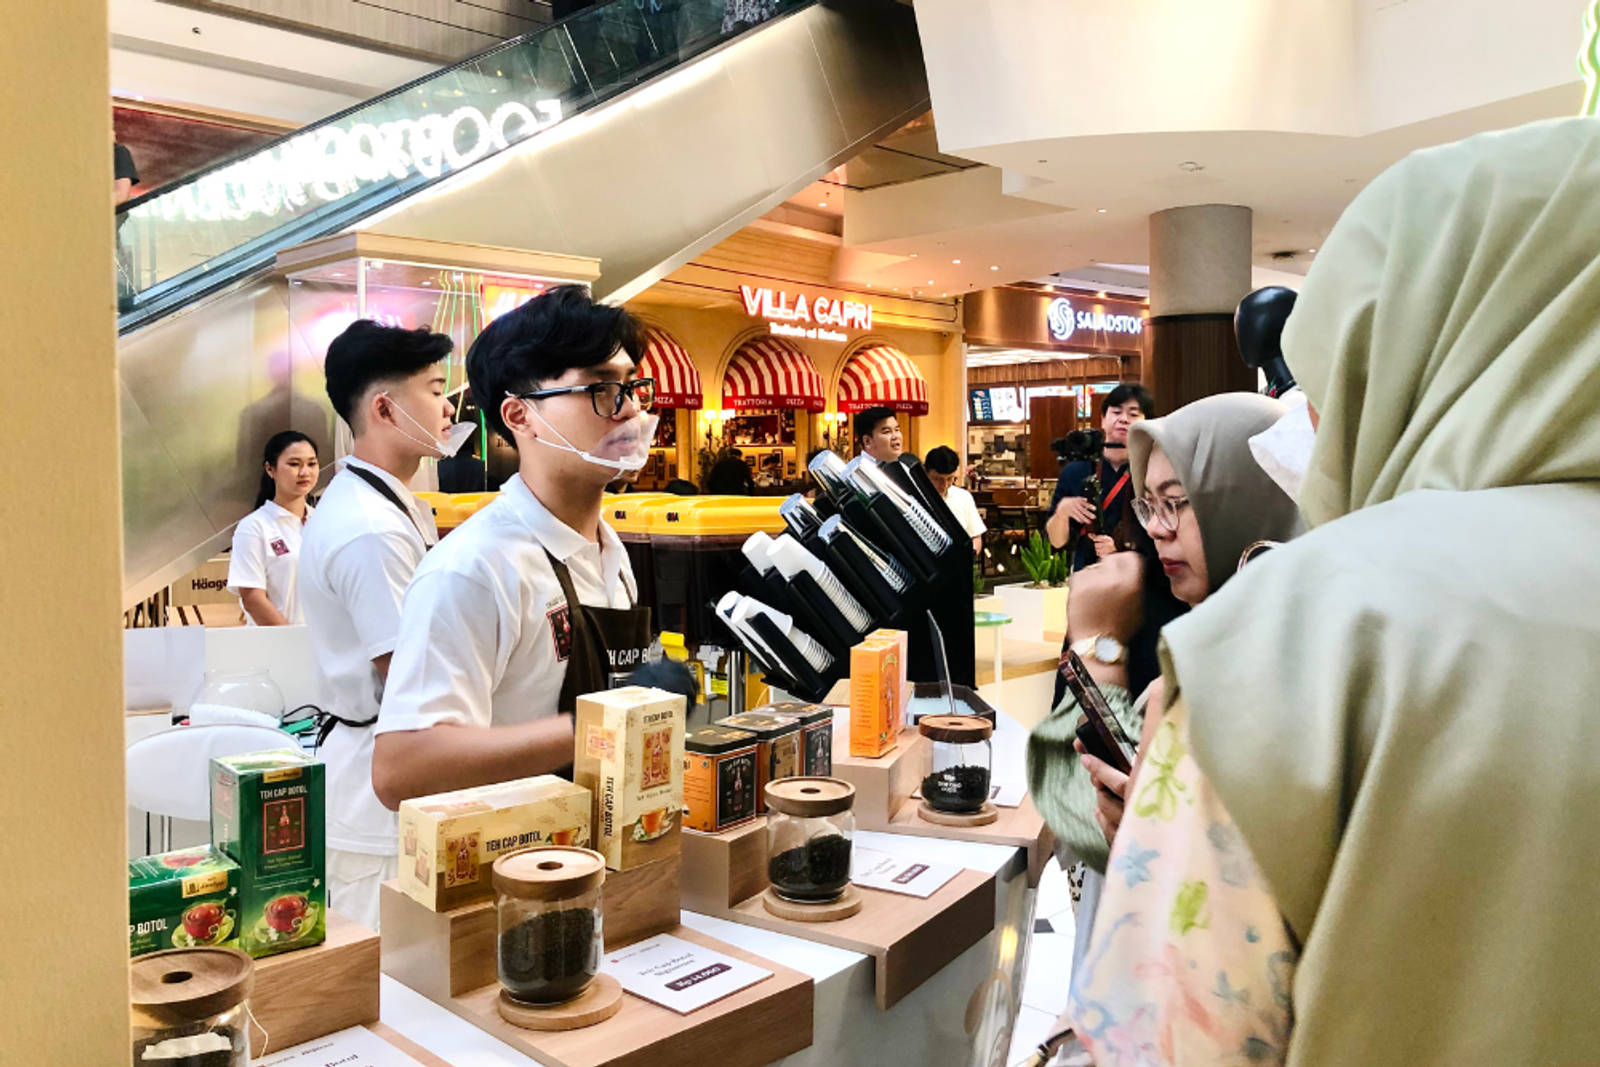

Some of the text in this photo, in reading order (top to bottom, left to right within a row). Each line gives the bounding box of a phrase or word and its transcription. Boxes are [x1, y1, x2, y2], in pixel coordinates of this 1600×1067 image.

[740, 285, 872, 330] VILLA CAPRI
[733, 398, 773, 407] TRATTORIA
[617, 647, 640, 665] CAP
[259, 788, 273, 800] TEH
[274, 786, 287, 798] CAP
[605, 793, 614, 811] CAP
[486, 838, 501, 852] TEH
[502, 835, 518, 849] CAP
[518, 829, 542, 844] BOTOL
[137, 918, 169, 936] BOTOL
